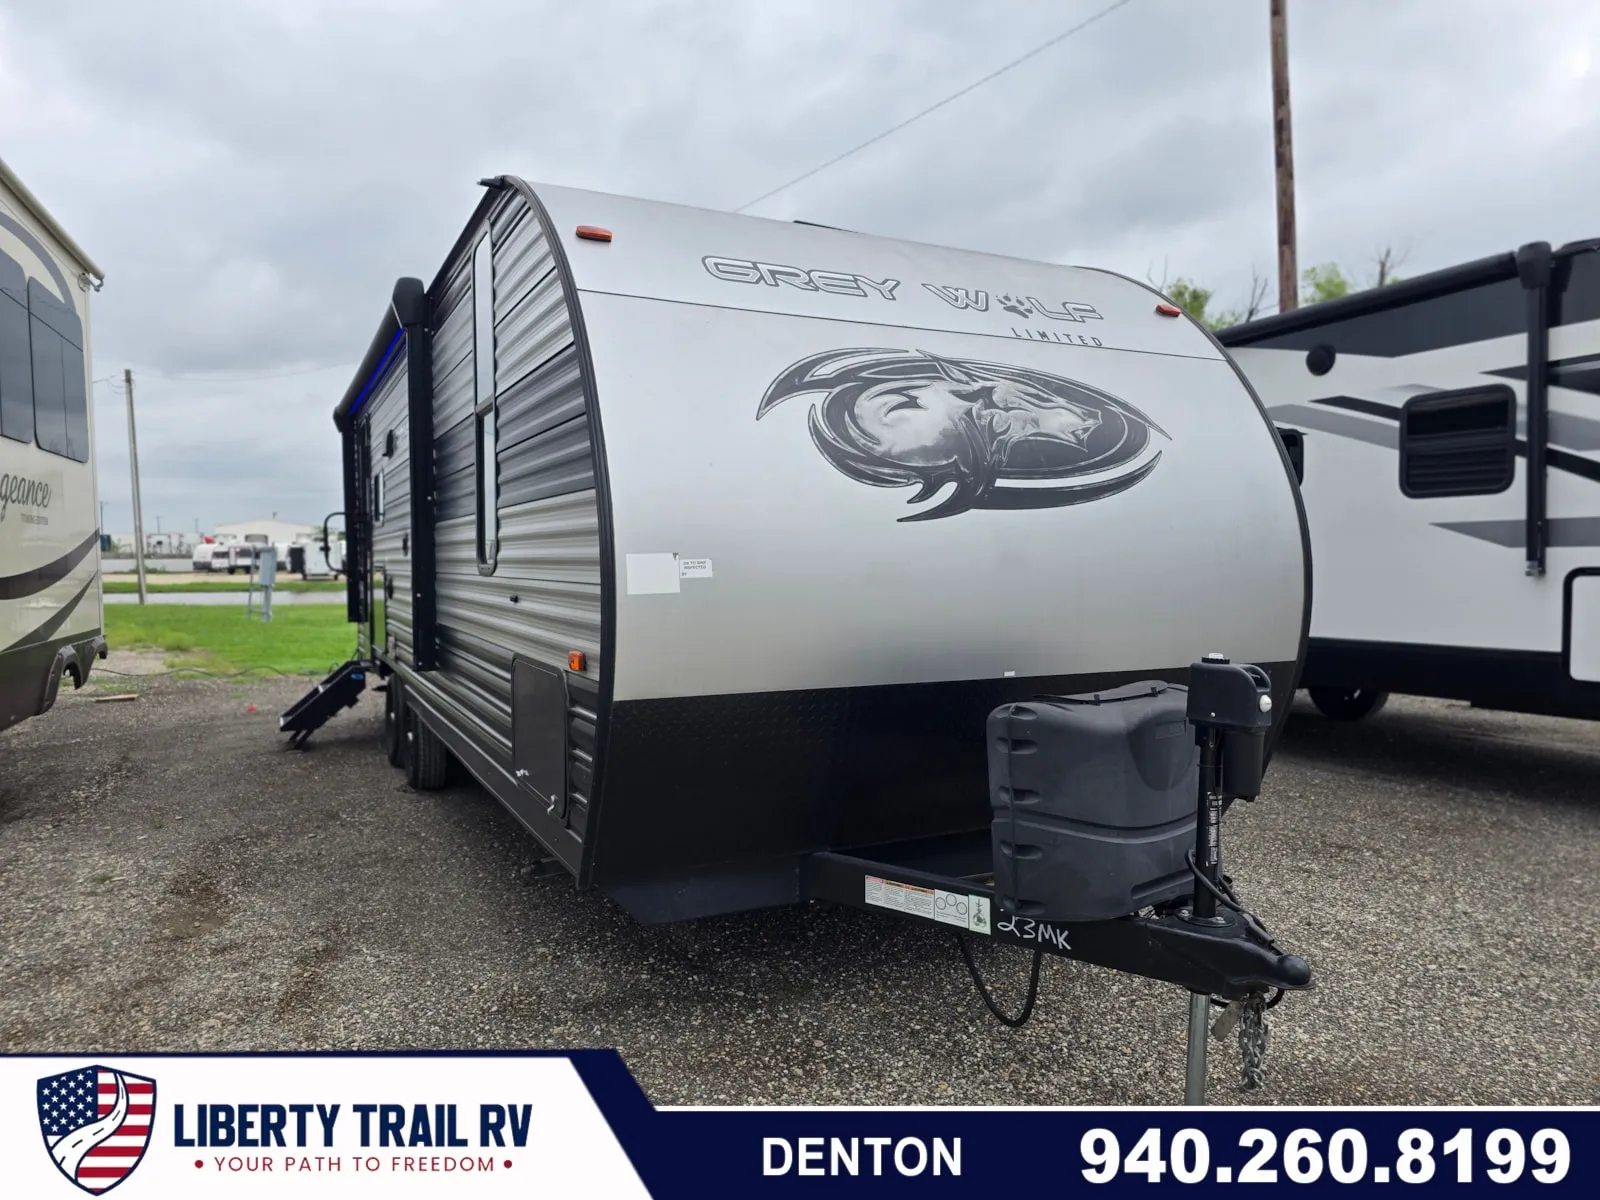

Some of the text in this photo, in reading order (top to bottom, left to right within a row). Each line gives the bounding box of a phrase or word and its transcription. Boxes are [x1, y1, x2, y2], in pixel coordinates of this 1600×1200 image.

[701, 255, 900, 301] GREY
[1011, 327, 1103, 347] LIMITED
[997, 915, 1072, 950] 23MK
